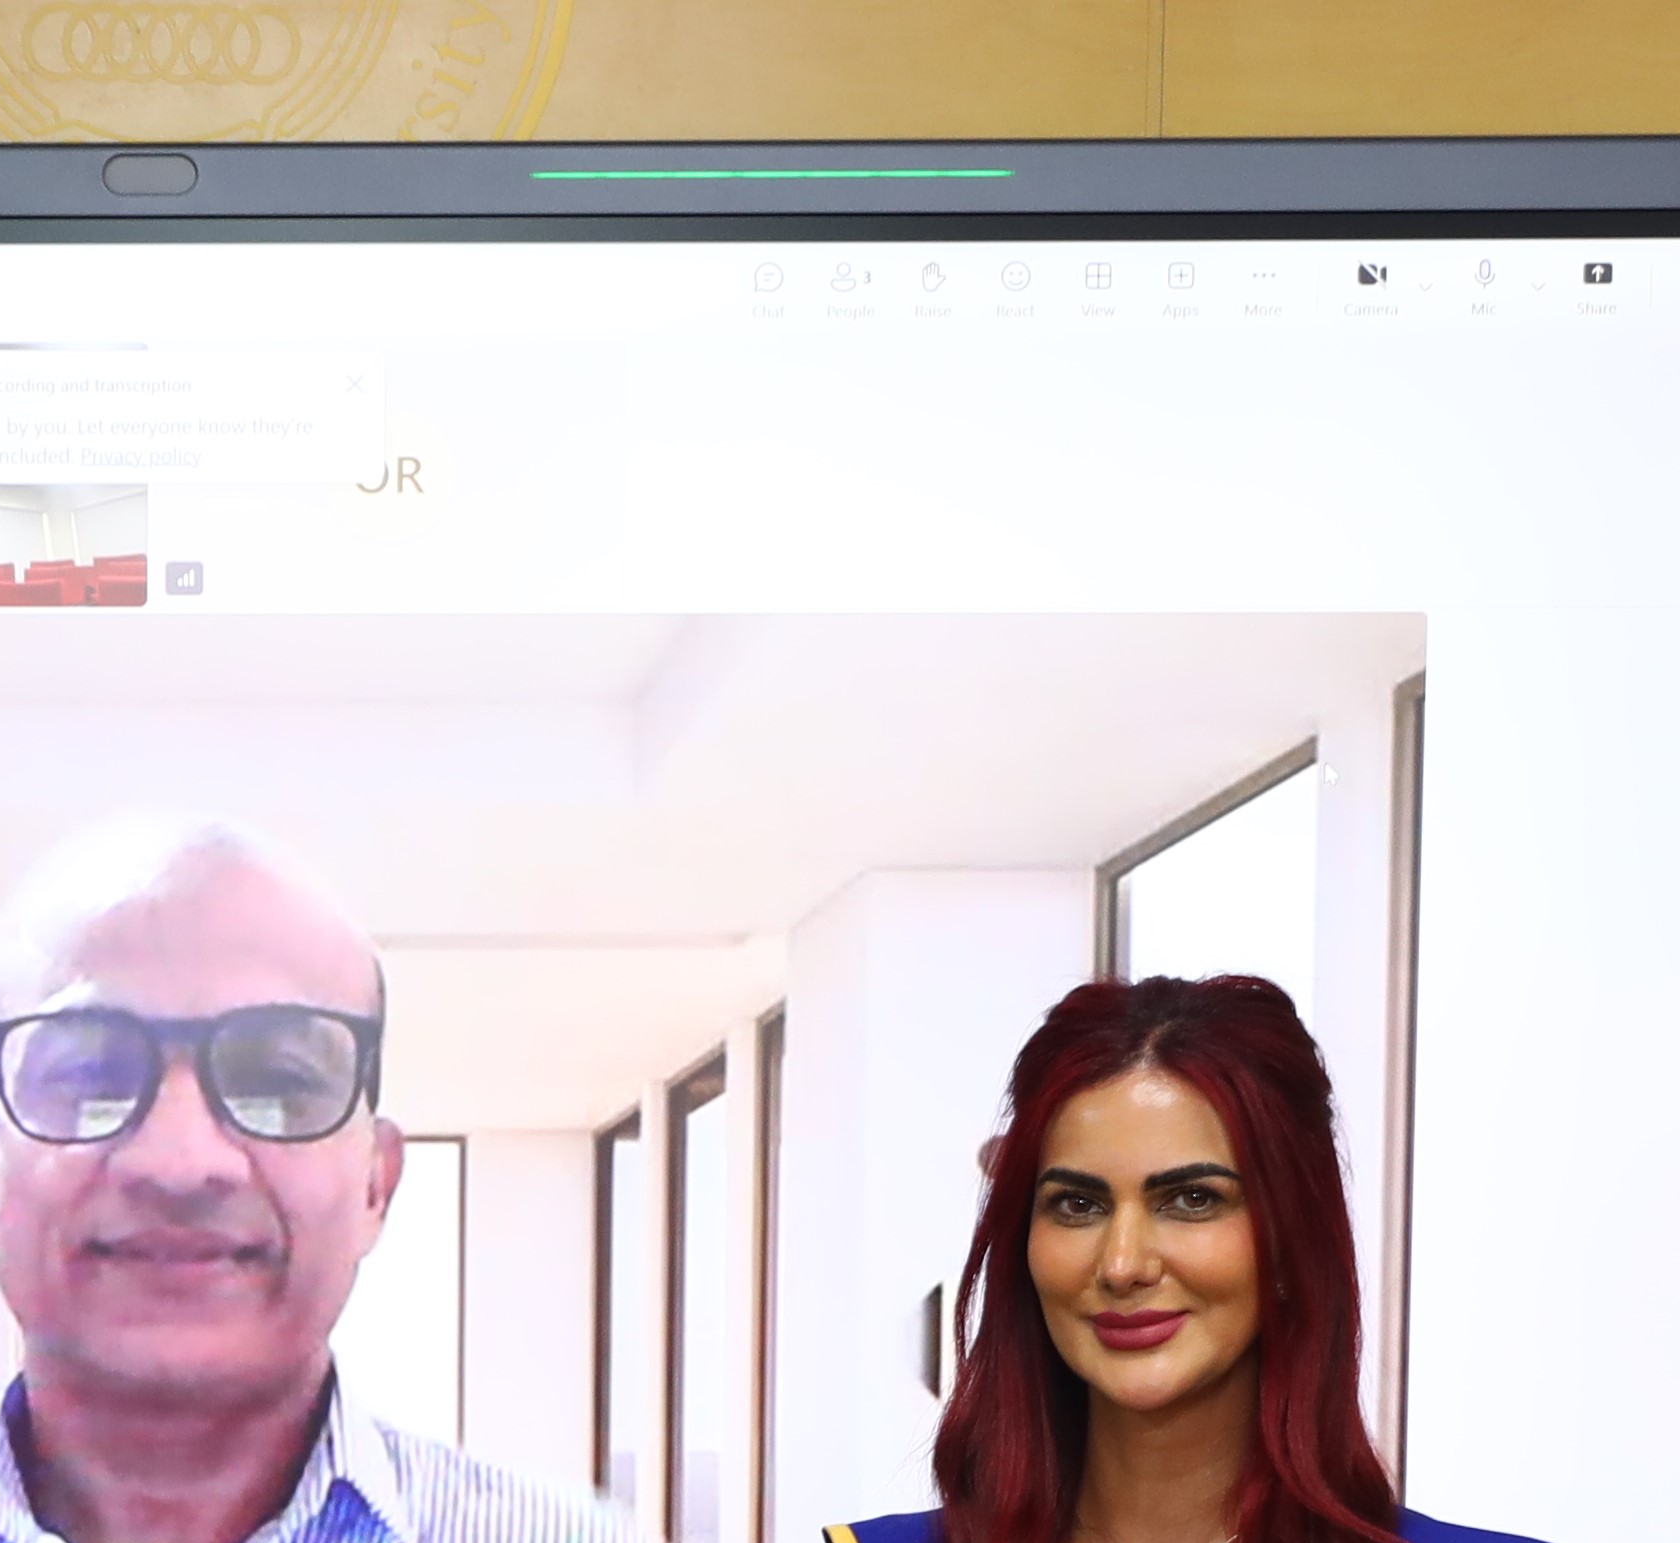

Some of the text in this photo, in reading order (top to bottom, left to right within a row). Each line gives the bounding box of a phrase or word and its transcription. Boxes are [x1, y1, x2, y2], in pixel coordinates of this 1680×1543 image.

[864, 270, 872, 284] 3
[751, 304, 784, 318] Chat
[827, 304, 876, 321] People
[914, 304, 952, 318] Raise
[996, 304, 1035, 318] React
[1081, 304, 1117, 317] View
[1162, 303, 1200, 321] Apps
[1244, 303, 1283, 317] More
[1343, 303, 1399, 317] Camera
[1471, 302, 1498, 316] Mic
[1576, 301, 1618, 315] Share
[60, 377, 90, 393] and
[94, 377, 192, 396] transcription
[7, 417, 29, 439] by
[33, 421, 72, 439] you.
[78, 418, 104, 435] Let
[109, 421, 193, 439] everyone
[198, 417, 246, 435] know
[252, 417, 313, 439] they're
[81, 447, 144, 469] Privacy
[148, 447, 202, 469] policy
